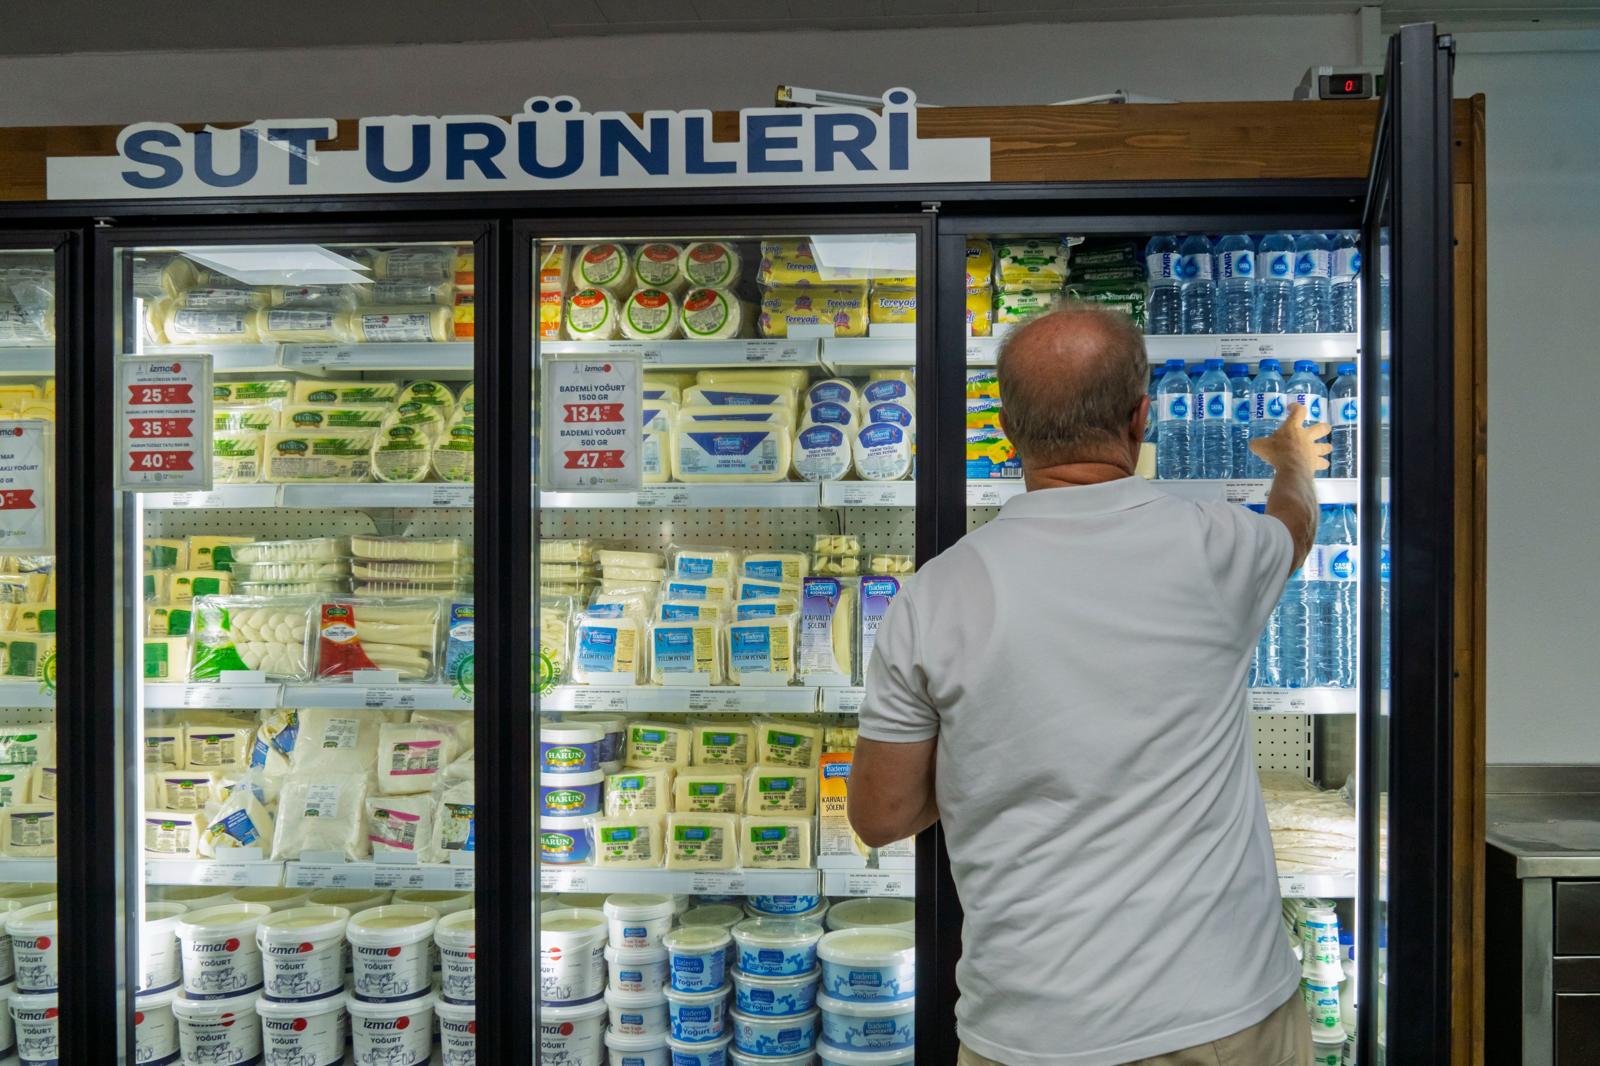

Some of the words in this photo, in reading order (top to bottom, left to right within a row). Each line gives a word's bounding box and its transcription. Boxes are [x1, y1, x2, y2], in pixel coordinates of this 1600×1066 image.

[560, 384, 593, 393] BADEMLİ
[594, 383, 625, 392] YOĞURT
[142, 388, 162, 402] 25
[571, 406, 602, 422] 134
[142, 421, 162, 436] 35
[560, 429, 593, 437] BADEMLİ
[594, 428, 626, 436] YOĞURT
[141, 454, 163, 468] 40
[577, 452, 599, 468] 47
[548, 751, 582, 760] HARUN
[548, 795, 582, 803] HARUN
[193, 941, 228, 953] izmar
[269, 943, 301, 955] izmar
[200, 959, 232, 967] YOĞURT
[275, 963, 305, 971] YOĞURT
[364, 962, 392, 970] YOĞURT
[266, 1018, 294, 1030] izmar
[363, 1018, 398, 1031] izmar
[442, 1018, 468, 1033] izmar
[195, 1034, 228, 1042] YOĞURT
[271, 1037, 299, 1045] YOĞURT
[370, 1037, 401, 1045] YOĞURT
[447, 1039, 473, 1047] YOĞURT
[541, 1041, 566, 1049] OĞURT
